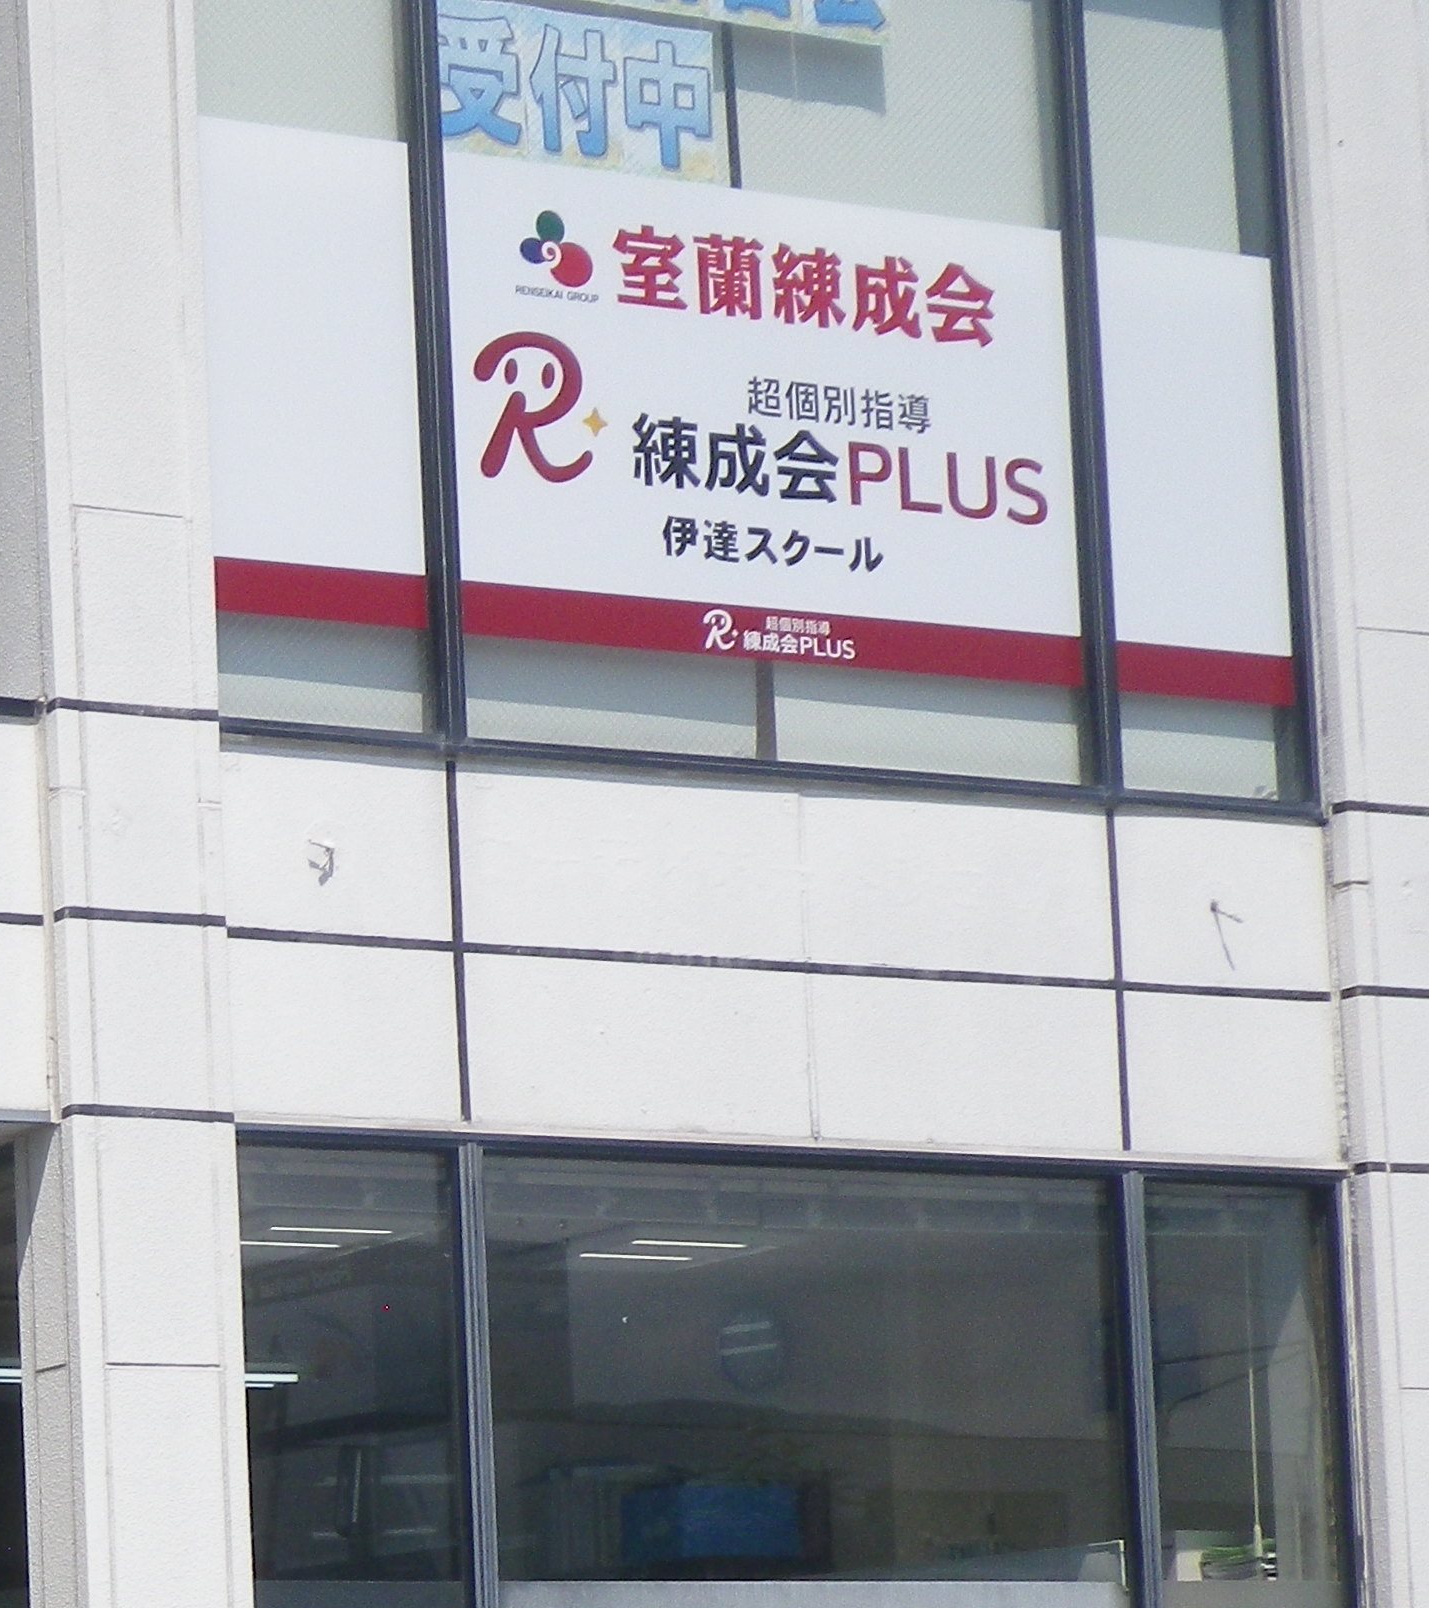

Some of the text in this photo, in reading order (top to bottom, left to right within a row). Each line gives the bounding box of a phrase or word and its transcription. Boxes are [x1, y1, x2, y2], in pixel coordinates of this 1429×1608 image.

[438, 14, 712, 171] 受付中
[567, 291, 599, 303] GROUP
[613, 224, 996, 348] 室蘭練成会
[747, 375, 931, 434] 超個別指導
[631, 410, 1049, 526] 練成会PLUS
[663, 515, 885, 573] 伊達スクール
